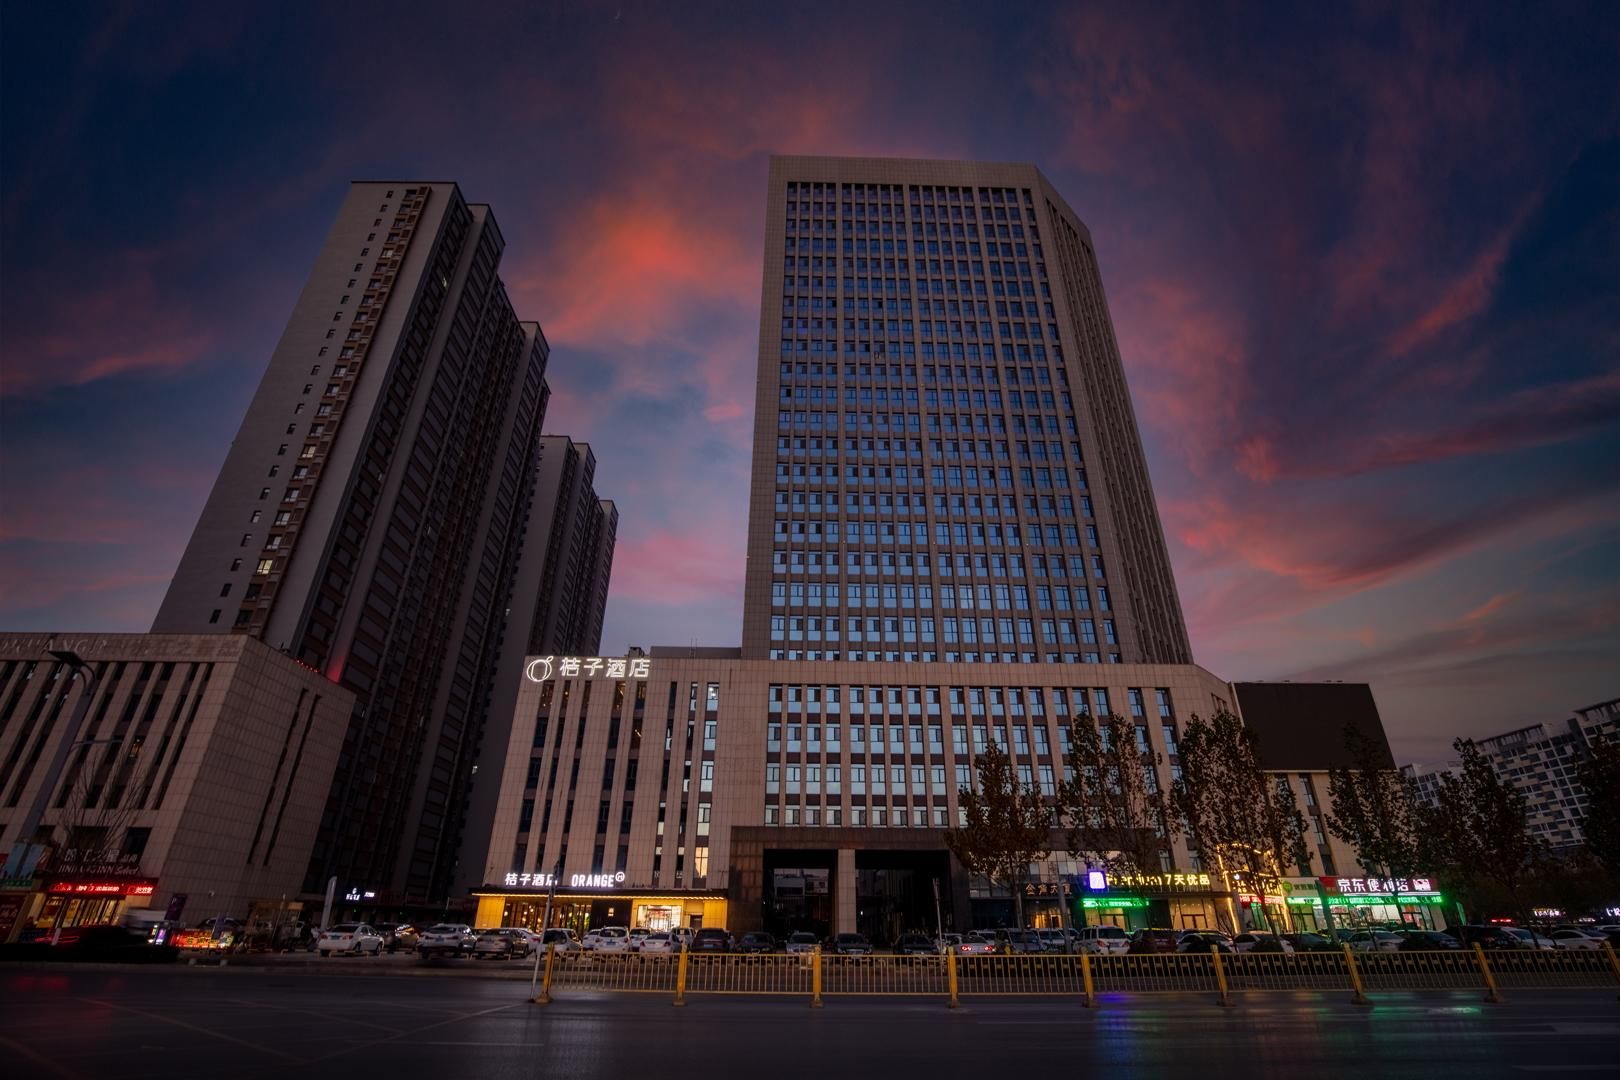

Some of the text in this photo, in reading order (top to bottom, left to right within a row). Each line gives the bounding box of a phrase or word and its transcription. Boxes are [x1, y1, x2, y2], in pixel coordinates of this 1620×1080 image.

[559, 657, 651, 678] 桔子酒店
[571, 873, 614, 888] ORANGE
[1164, 873, 1211, 886] 7天优品
